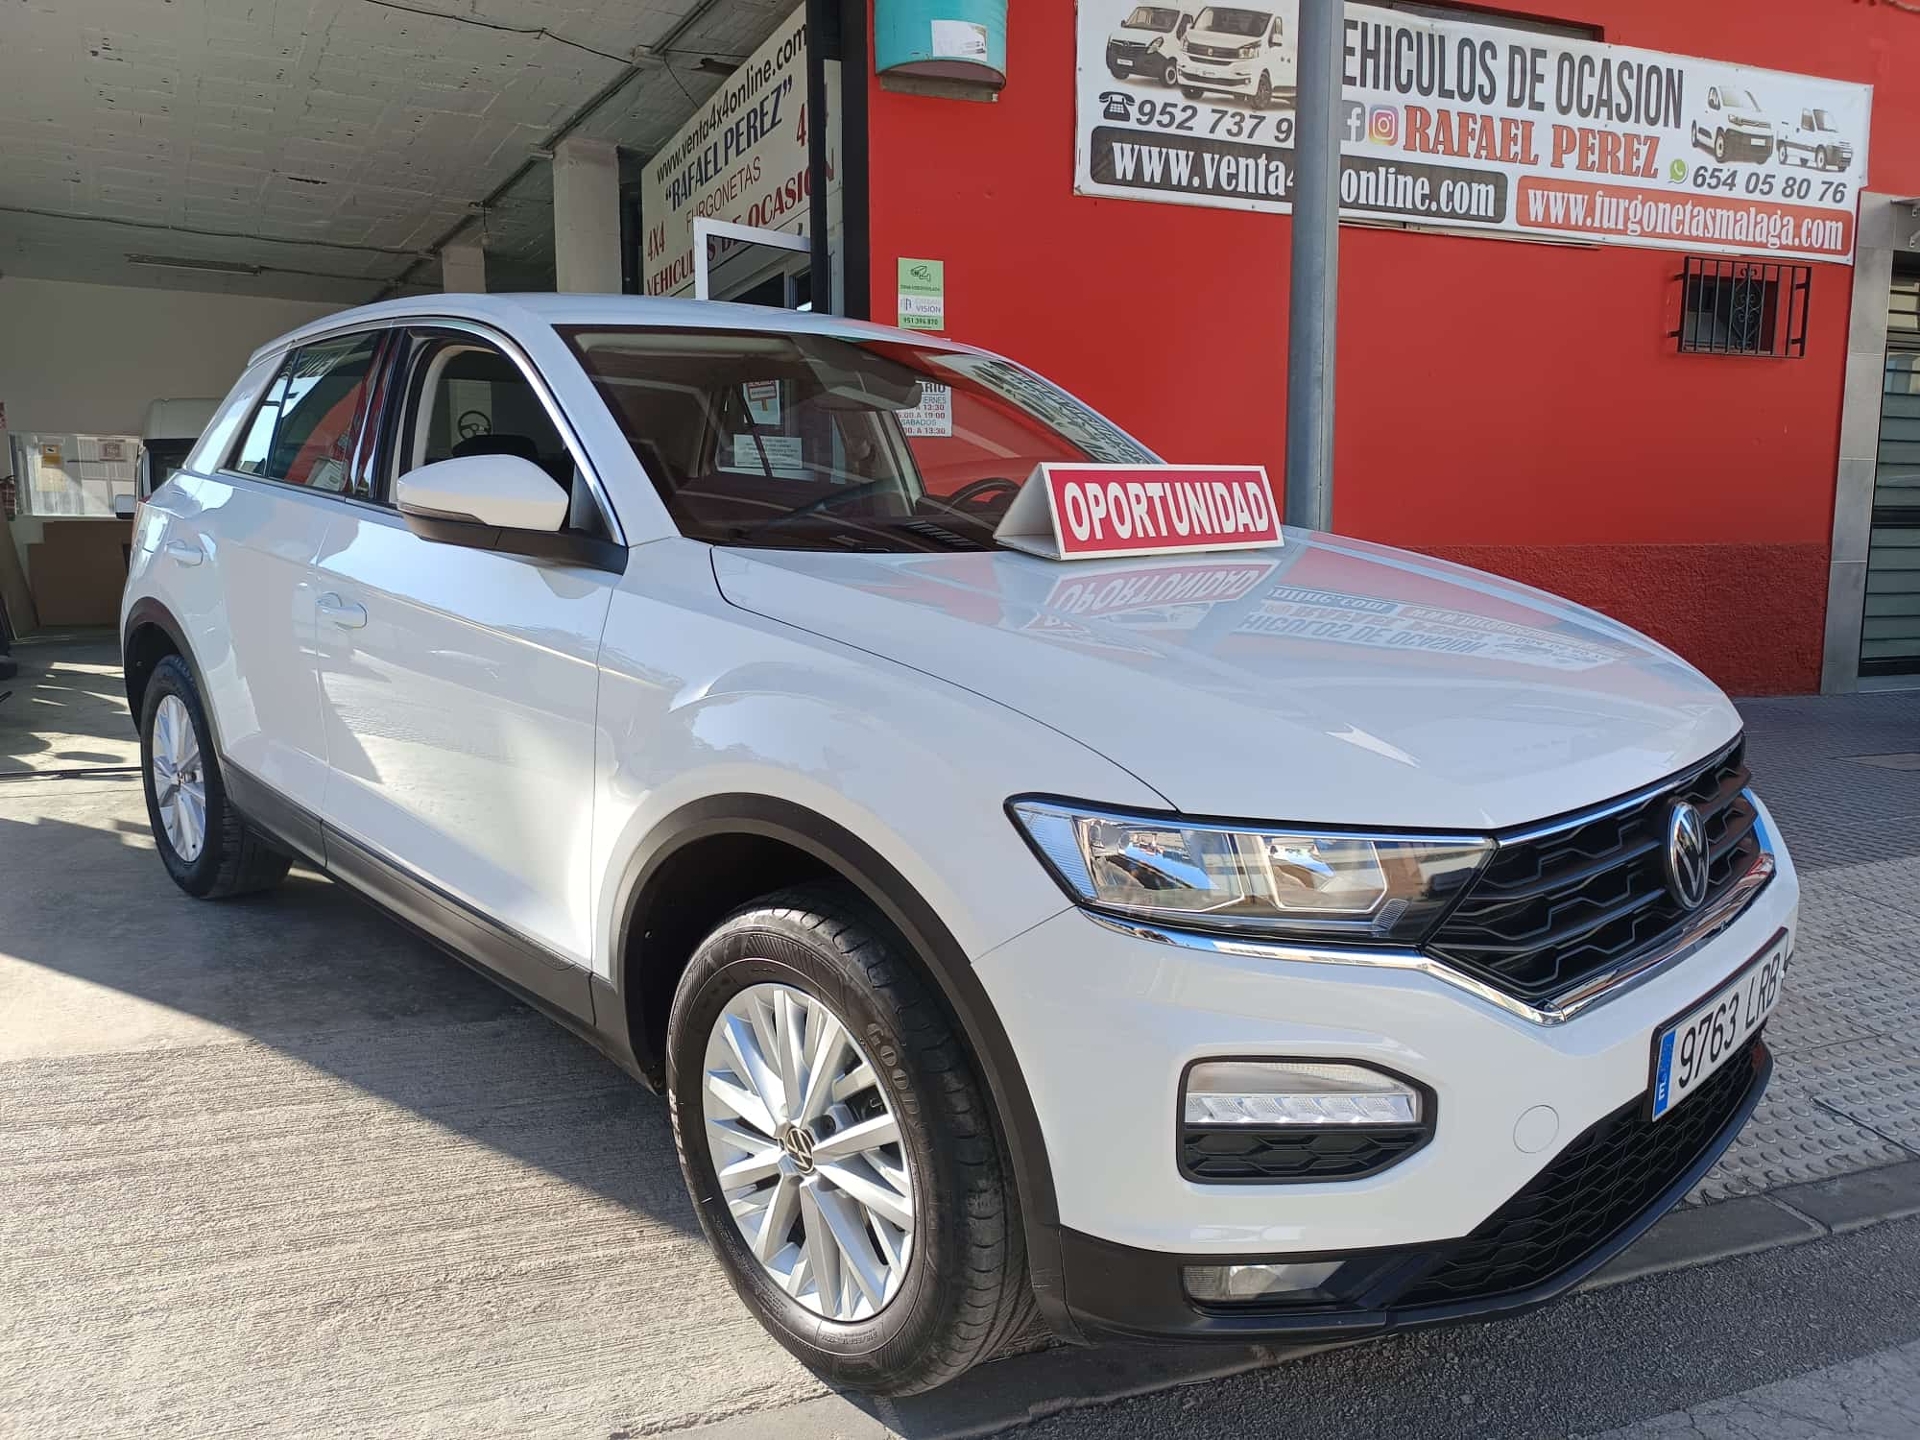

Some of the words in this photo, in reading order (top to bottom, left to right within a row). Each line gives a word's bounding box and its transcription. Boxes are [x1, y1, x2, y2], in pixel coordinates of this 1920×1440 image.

[656, 24, 807, 185] www.venta4x4online.com
[1342, 18, 1498, 105] EHICULOS
[1507, 45, 1547, 112] DE
[1554, 51, 1684, 129] OCASION
[1135, 99, 1198, 132] 952
[1208, 108, 1266, 139] 737
[1404, 105, 1538, 166] RAFAEL
[1550, 124, 1660, 179] PEREZ
[685, 155, 762, 234] FURGONETAS
[1692, 165, 1736, 191] 654
[1745, 171, 1776, 196] 05
[1781, 176, 1811, 201] 80
[1818, 180, 1847, 204] 76
[647, 219, 666, 262] 4X4
[1527, 188, 1844, 251] www.furgonetasmalaga.com
[647, 236, 717, 296] VEHICULS
[1064, 480, 1269, 542] OPORTUNIDAD
[1678, 991, 1740, 1089] 9763
[1745, 952, 1781, 1030] LRB
